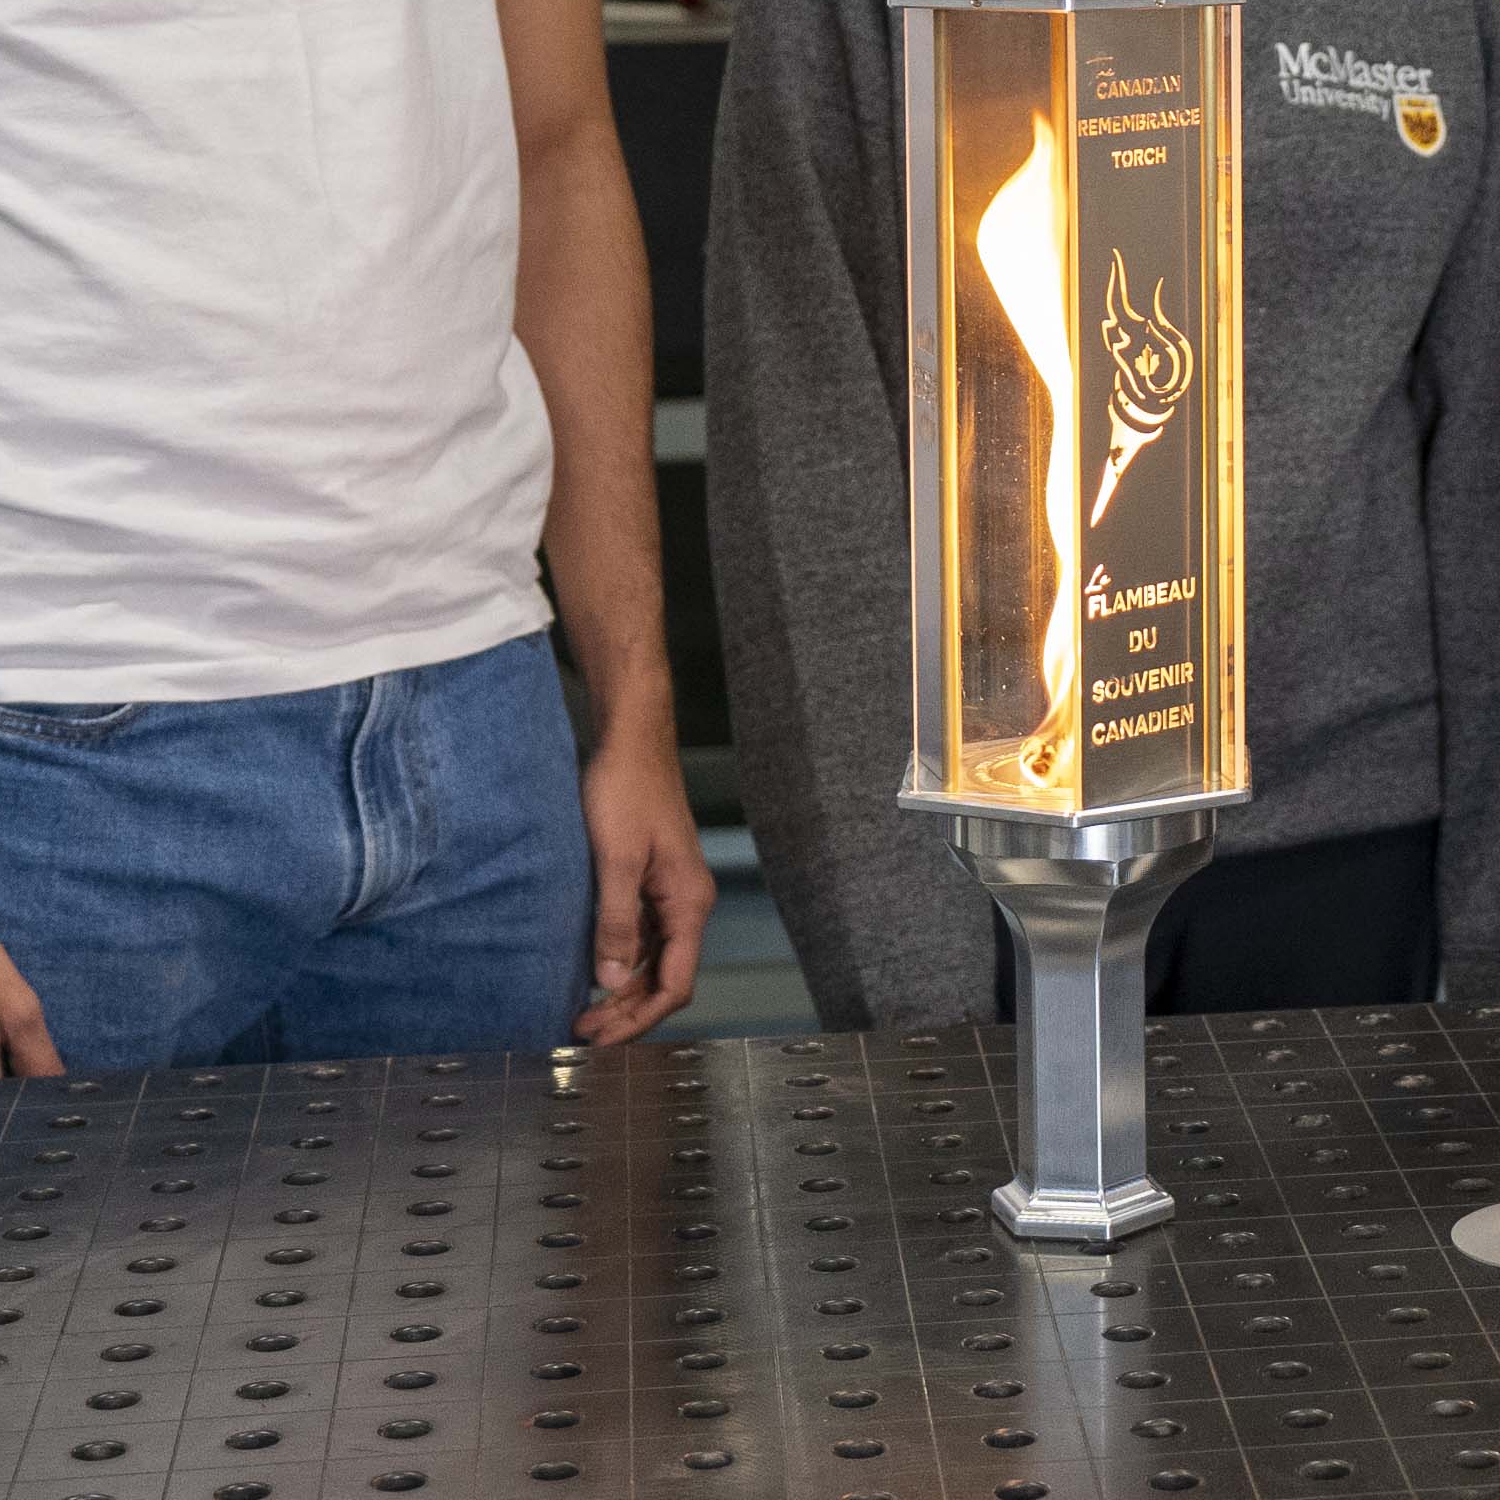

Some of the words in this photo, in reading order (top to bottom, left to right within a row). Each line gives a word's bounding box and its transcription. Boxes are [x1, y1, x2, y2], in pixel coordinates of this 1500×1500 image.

[1274, 42, 1434, 92] McMaster
[1096, 75, 1180, 100] CANADIAN
[1279, 79, 1391, 122] University
[1078, 107, 1200, 137] REMEMBRANCE
[1111, 146, 1167, 169] TORCH
[1084, 563, 1112, 595] Le
[1088, 577, 1196, 621] FLAMBEAU
[1129, 626, 1157, 653] DU
[1092, 661, 1195, 703] SOUVENIR
[1091, 703, 1195, 746] CANADIEN
